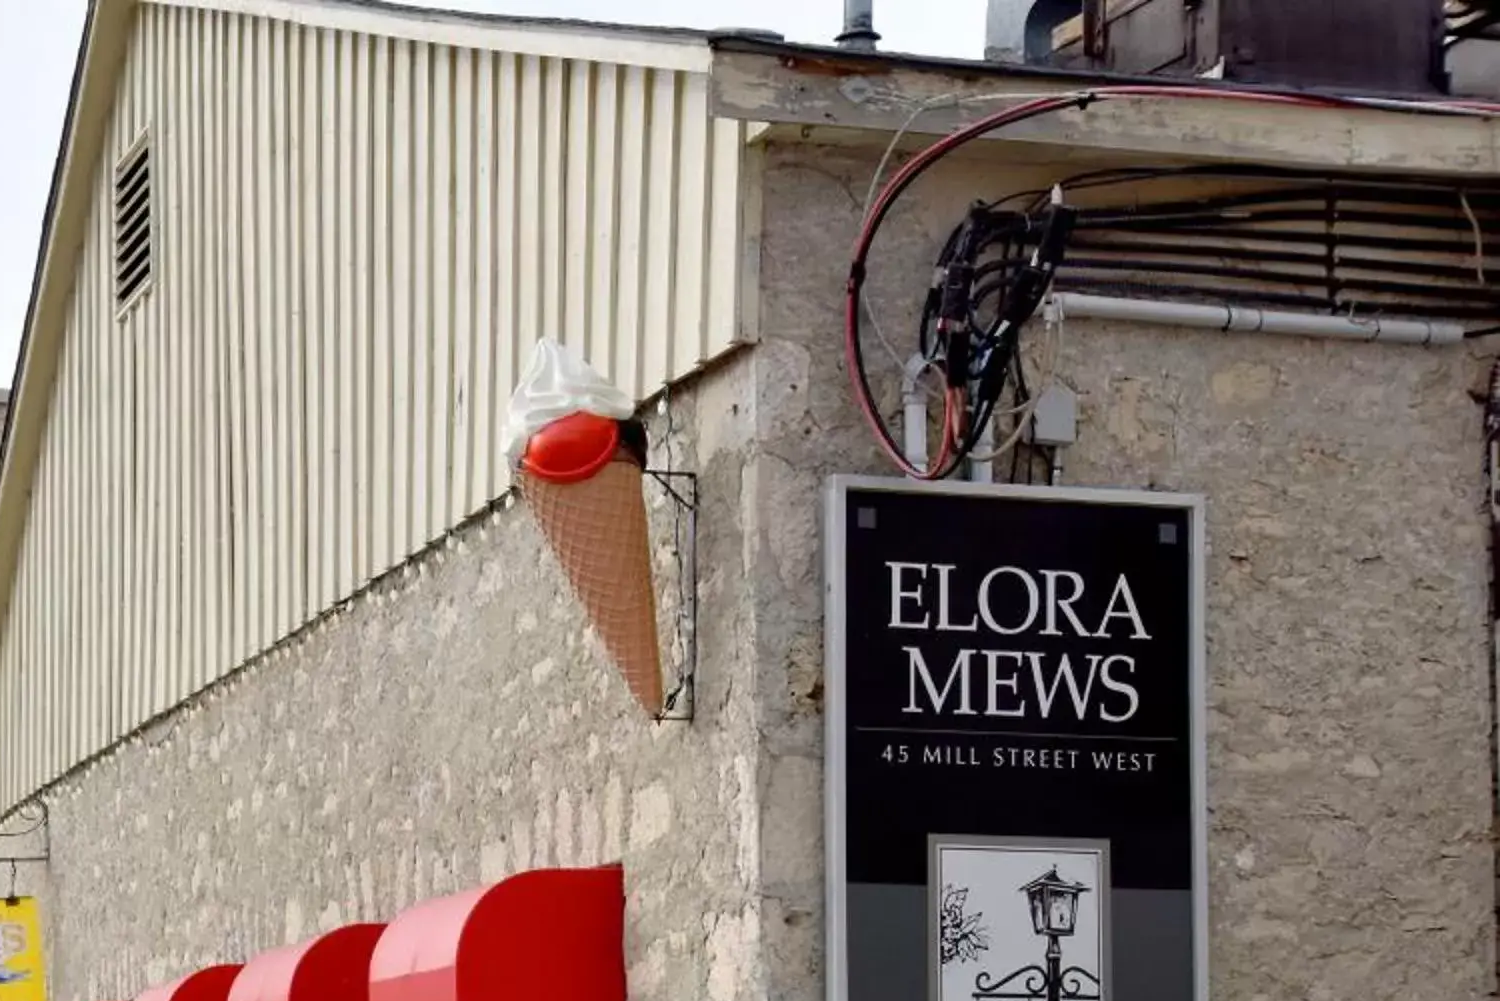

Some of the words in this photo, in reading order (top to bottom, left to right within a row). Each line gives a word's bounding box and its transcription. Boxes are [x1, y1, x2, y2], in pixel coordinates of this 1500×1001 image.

[885, 560, 1152, 640] ELORA
[901, 646, 1139, 722] MEWS
[881, 744, 909, 763] 45
[922, 746, 981, 766] MILL
[992, 747, 1080, 769] STREET
[1091, 751, 1157, 772] WEST
